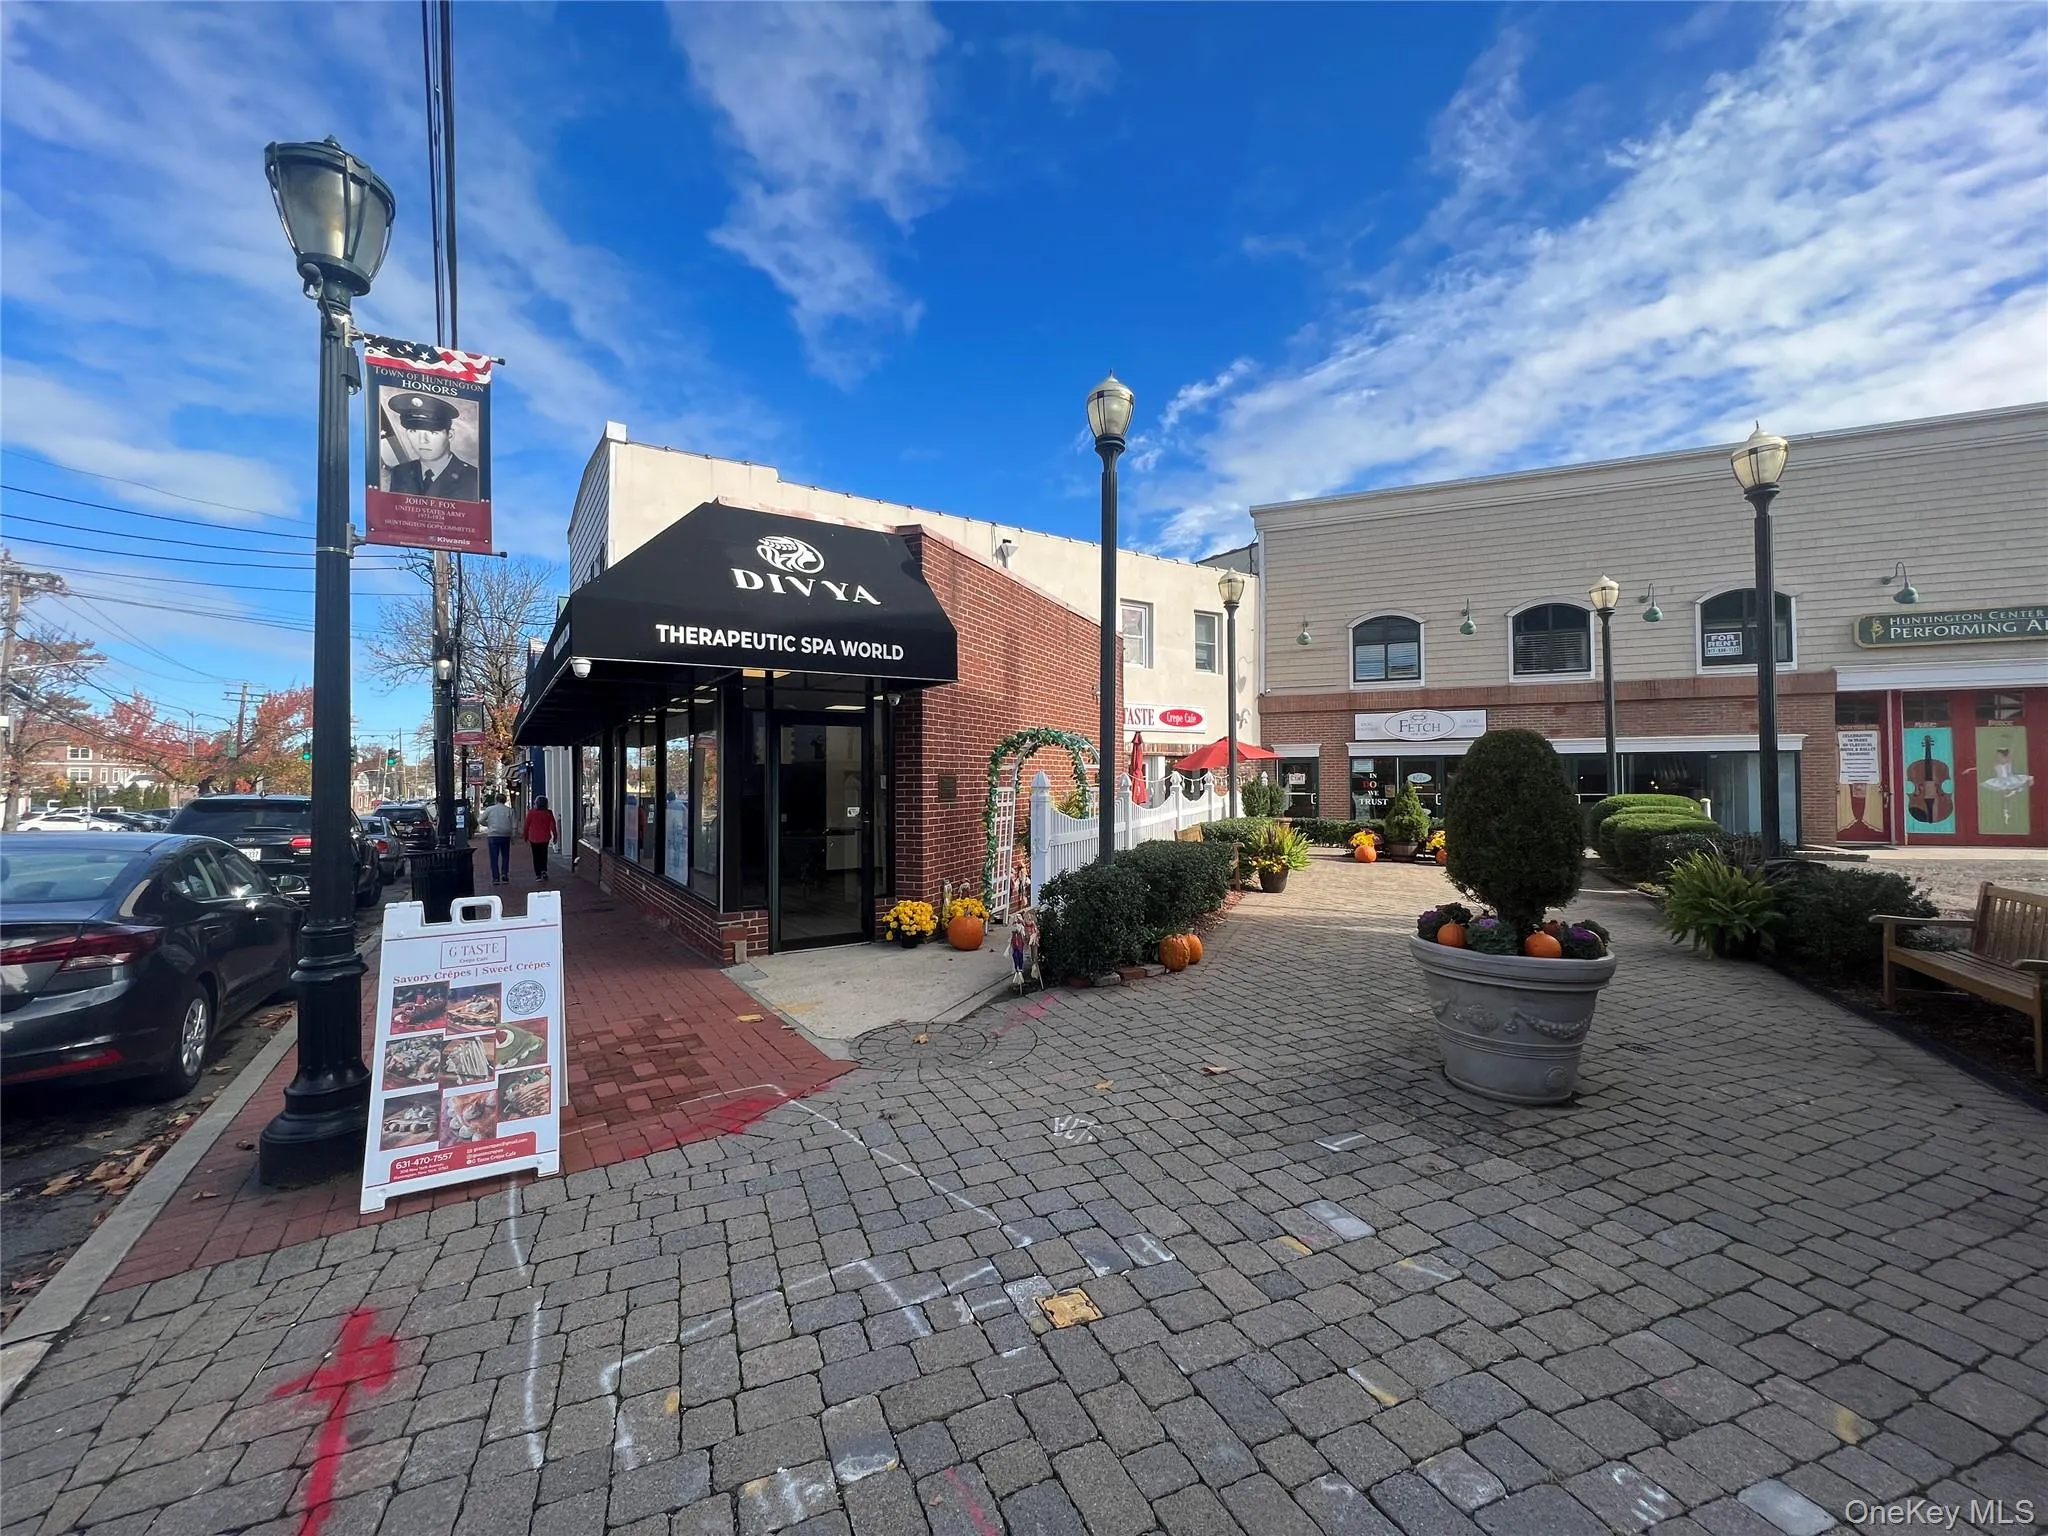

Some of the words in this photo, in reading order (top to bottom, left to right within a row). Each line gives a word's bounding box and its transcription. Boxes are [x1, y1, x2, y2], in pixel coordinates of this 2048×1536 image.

[374, 365, 404, 378] TOWN
[406, 371, 418, 380] OF
[421, 374, 484, 393] HUNTINGTON
[402, 379, 458, 396] HONORS
[394, 504, 421, 513] UNITED
[405, 497, 428, 507] JOHN
[438, 501, 457, 510] FOX
[437, 536, 471, 546] Kiwanis
[730, 567, 881, 606] DIVYA
[1889, 612, 1983, 626] HUNTINGTON
[1988, 609, 2045, 620] CENTER
[1890, 621, 2017, 640] PERFORMING
[2026, 618, 2048, 632] A
[655, 624, 796, 652] THERAPEUTIC
[800, 636, 836, 656] SPA
[840, 639, 904, 661] WORLD
[1707, 640, 1739, 648] RENT
[1711, 634, 1735, 642] FOR
[1367, 789, 1380, 797] WE
[1359, 798, 1389, 806] TRUST
[460, 942, 499, 957] TASTE
[392, 974, 431, 985] Savory
[434, 969, 472, 982] Crêpes
[481, 965, 514, 975] Sweet
[394, 1151, 455, 1170] 631-470-7557
